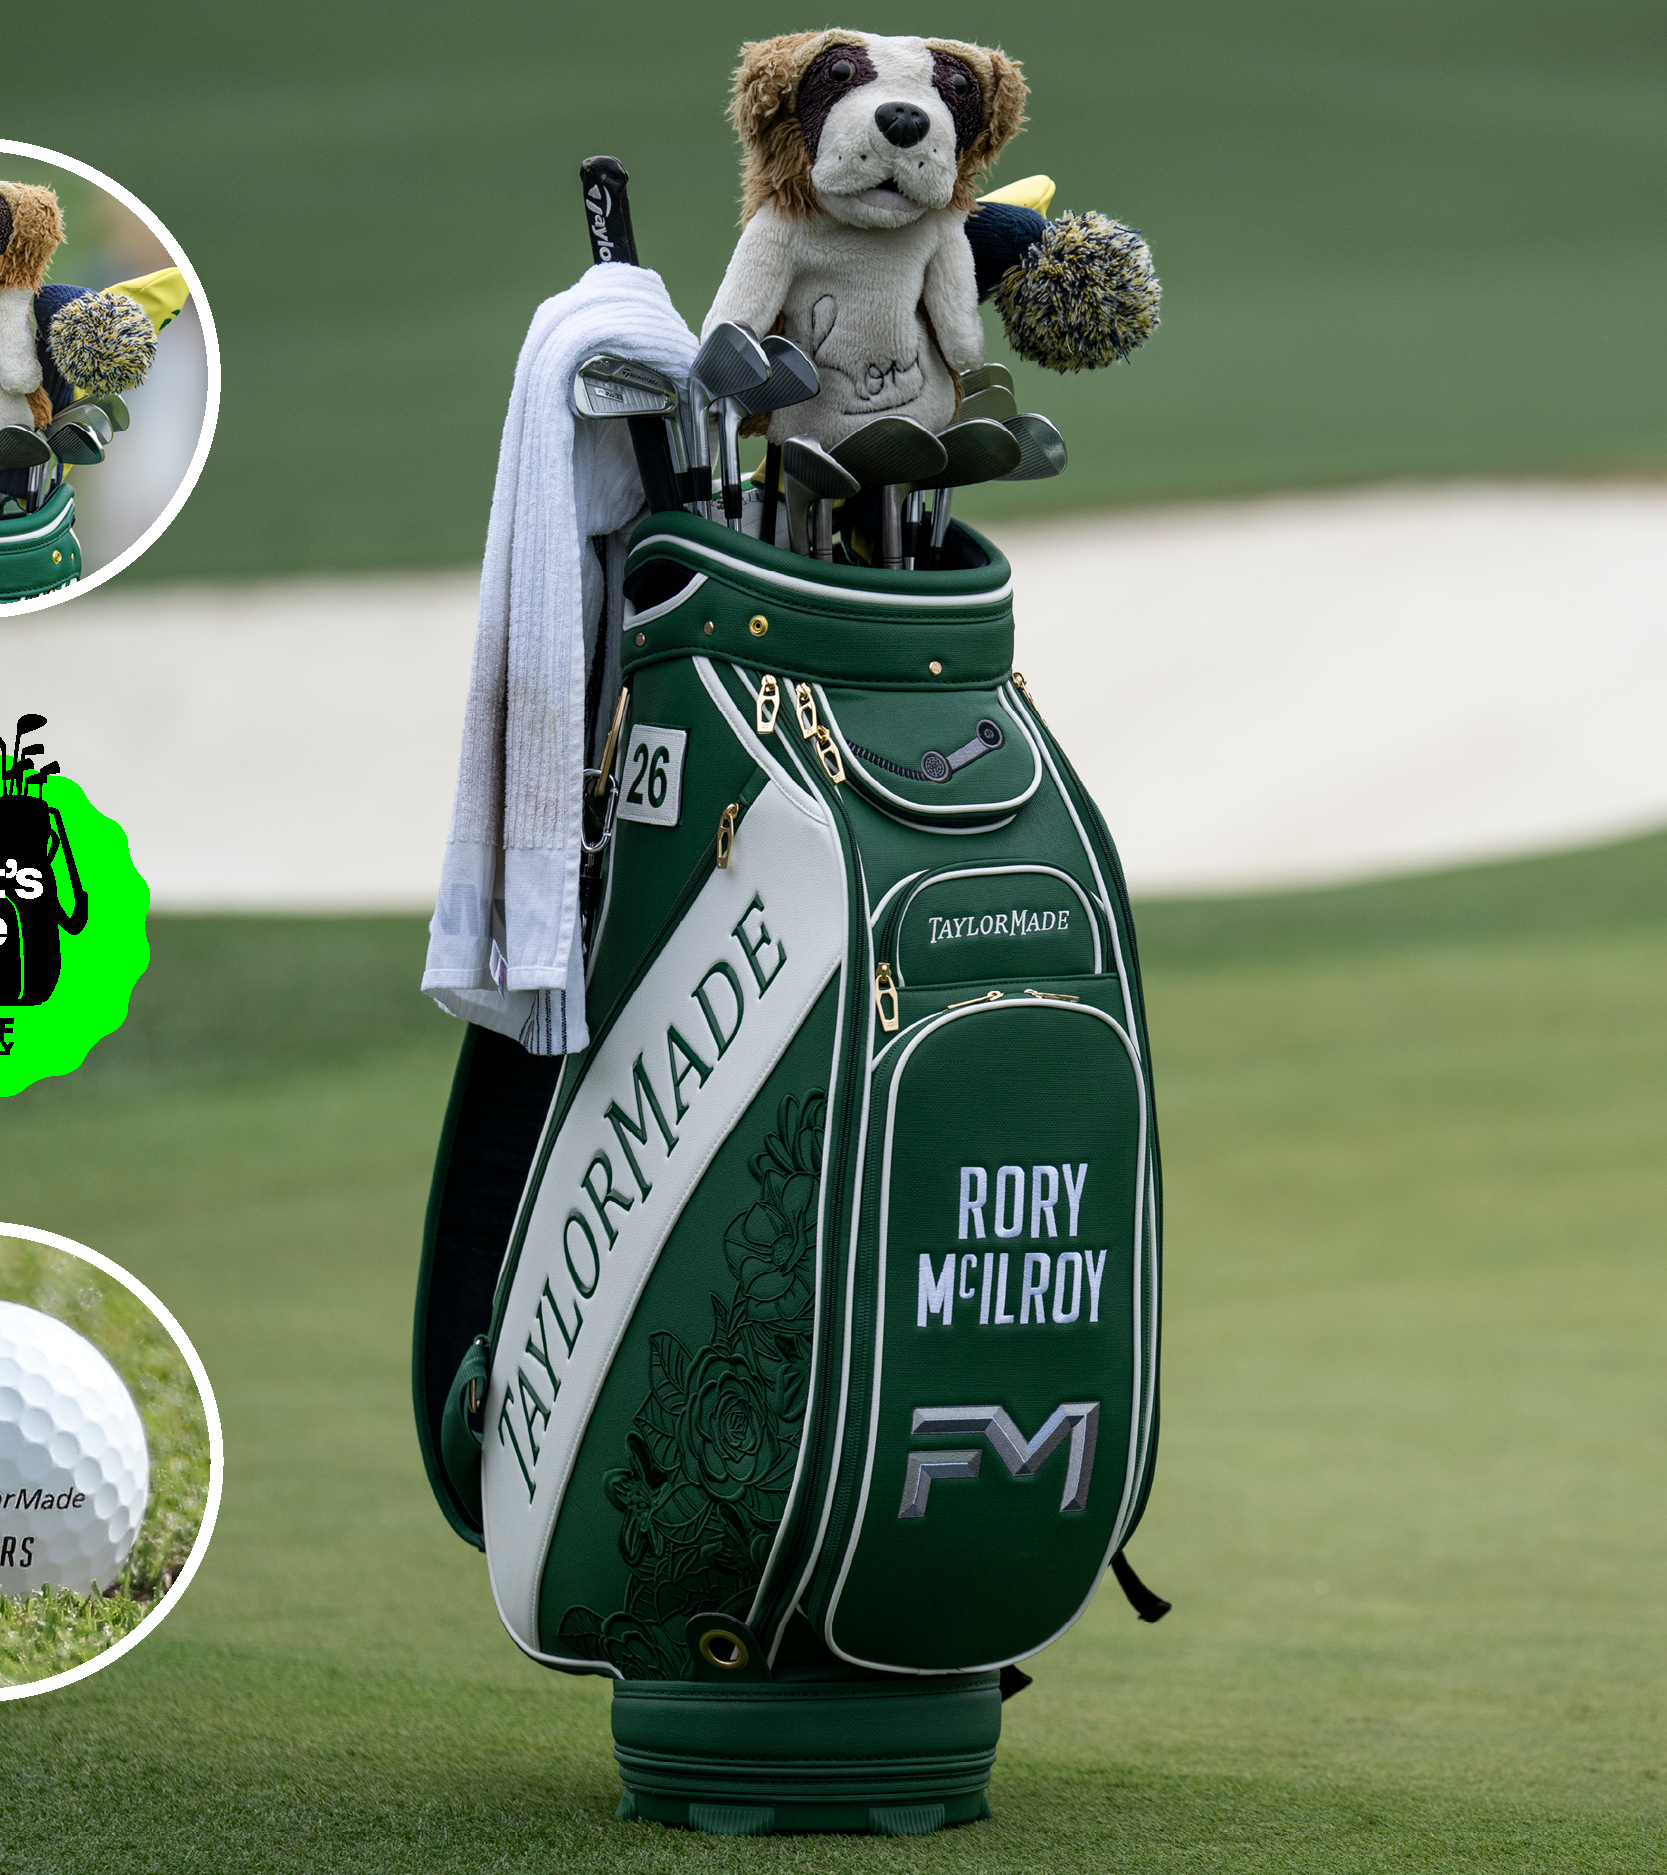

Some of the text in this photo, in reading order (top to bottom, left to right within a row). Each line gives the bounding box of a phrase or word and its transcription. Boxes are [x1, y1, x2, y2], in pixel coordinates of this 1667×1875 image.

[585, 183, 615, 262] Taylo
[625, 743, 671, 809] 26
[957, 1163, 1090, 1240] RORY
